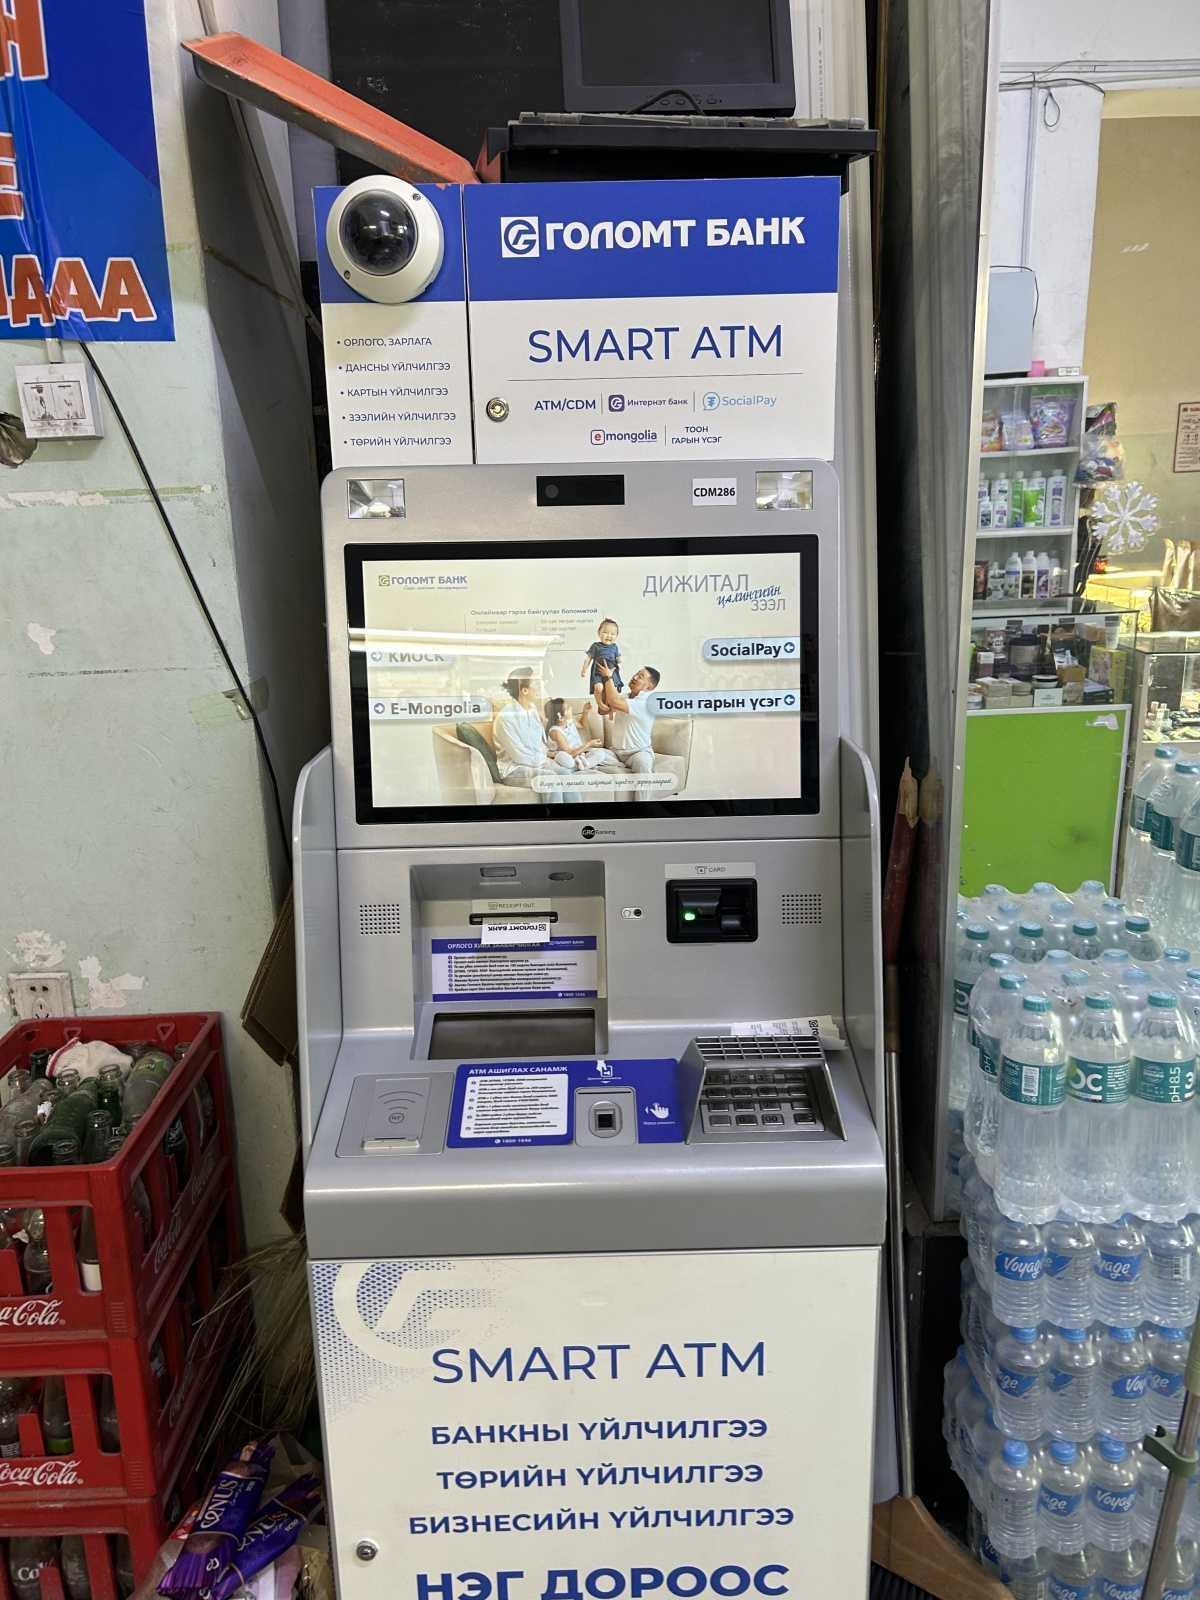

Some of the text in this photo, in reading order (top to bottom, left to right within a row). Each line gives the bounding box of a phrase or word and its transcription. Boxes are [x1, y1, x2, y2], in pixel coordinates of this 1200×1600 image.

[546, 217, 806, 250] ГОЛОМТ БАНК
[344, 337, 432, 347] ОРЛОГО, ЗАРЛАГА
[528, 324, 783, 363] SMART ATM
[345, 361, 451, 373] ДАНСНЫ ҮЙЛЧИЛГЭЭ
[347, 386, 449, 397] КАРТЫН ҮЙЛЧИЛГЭЭ
[534, 398, 596, 412] ATM/CDM
[627, 397, 689, 408] Интернэт банк
[722, 395, 777, 408] SocialPay
[348, 411, 456, 422] ЗЭЭЛИЙН ҮЙЛЧИЛГЭЭ
[684, 426, 709, 434] ТООН
[350, 435, 452, 446] ТӨРИЙН ҮЙЛЧИЛГЭЭ
[671, 436, 722, 445] ГАРЫН ҮСЭГ
[693, 487, 736, 497] CDM286
[391, 575, 468, 585] ГОЛОМТ БАНК
[643, 574, 749, 597] ДИЖИТАЛ
[751, 599, 786, 612] ЗЭЭЛ
[711, 643, 782, 658] SocialPay
[390, 702, 481, 717] E-Mongolia
[656, 697, 783, 712] Тоон гарын үсэг
[431, 1341, 766, 1384] SMART ATM
[431, 1417, 768, 1446] БАНКНЫ ҮЙЛЧИЛГЭЭ
[436, 1462, 764, 1490] ТӨРИЙН ҮЙЛЧИЛГЭЭ
[409, 1506, 795, 1534] БИЗНЕСИЙН ҮЙЛЧИЛГЭЭ
[415, 1564, 791, 1600] НЭГ ДОРООС
